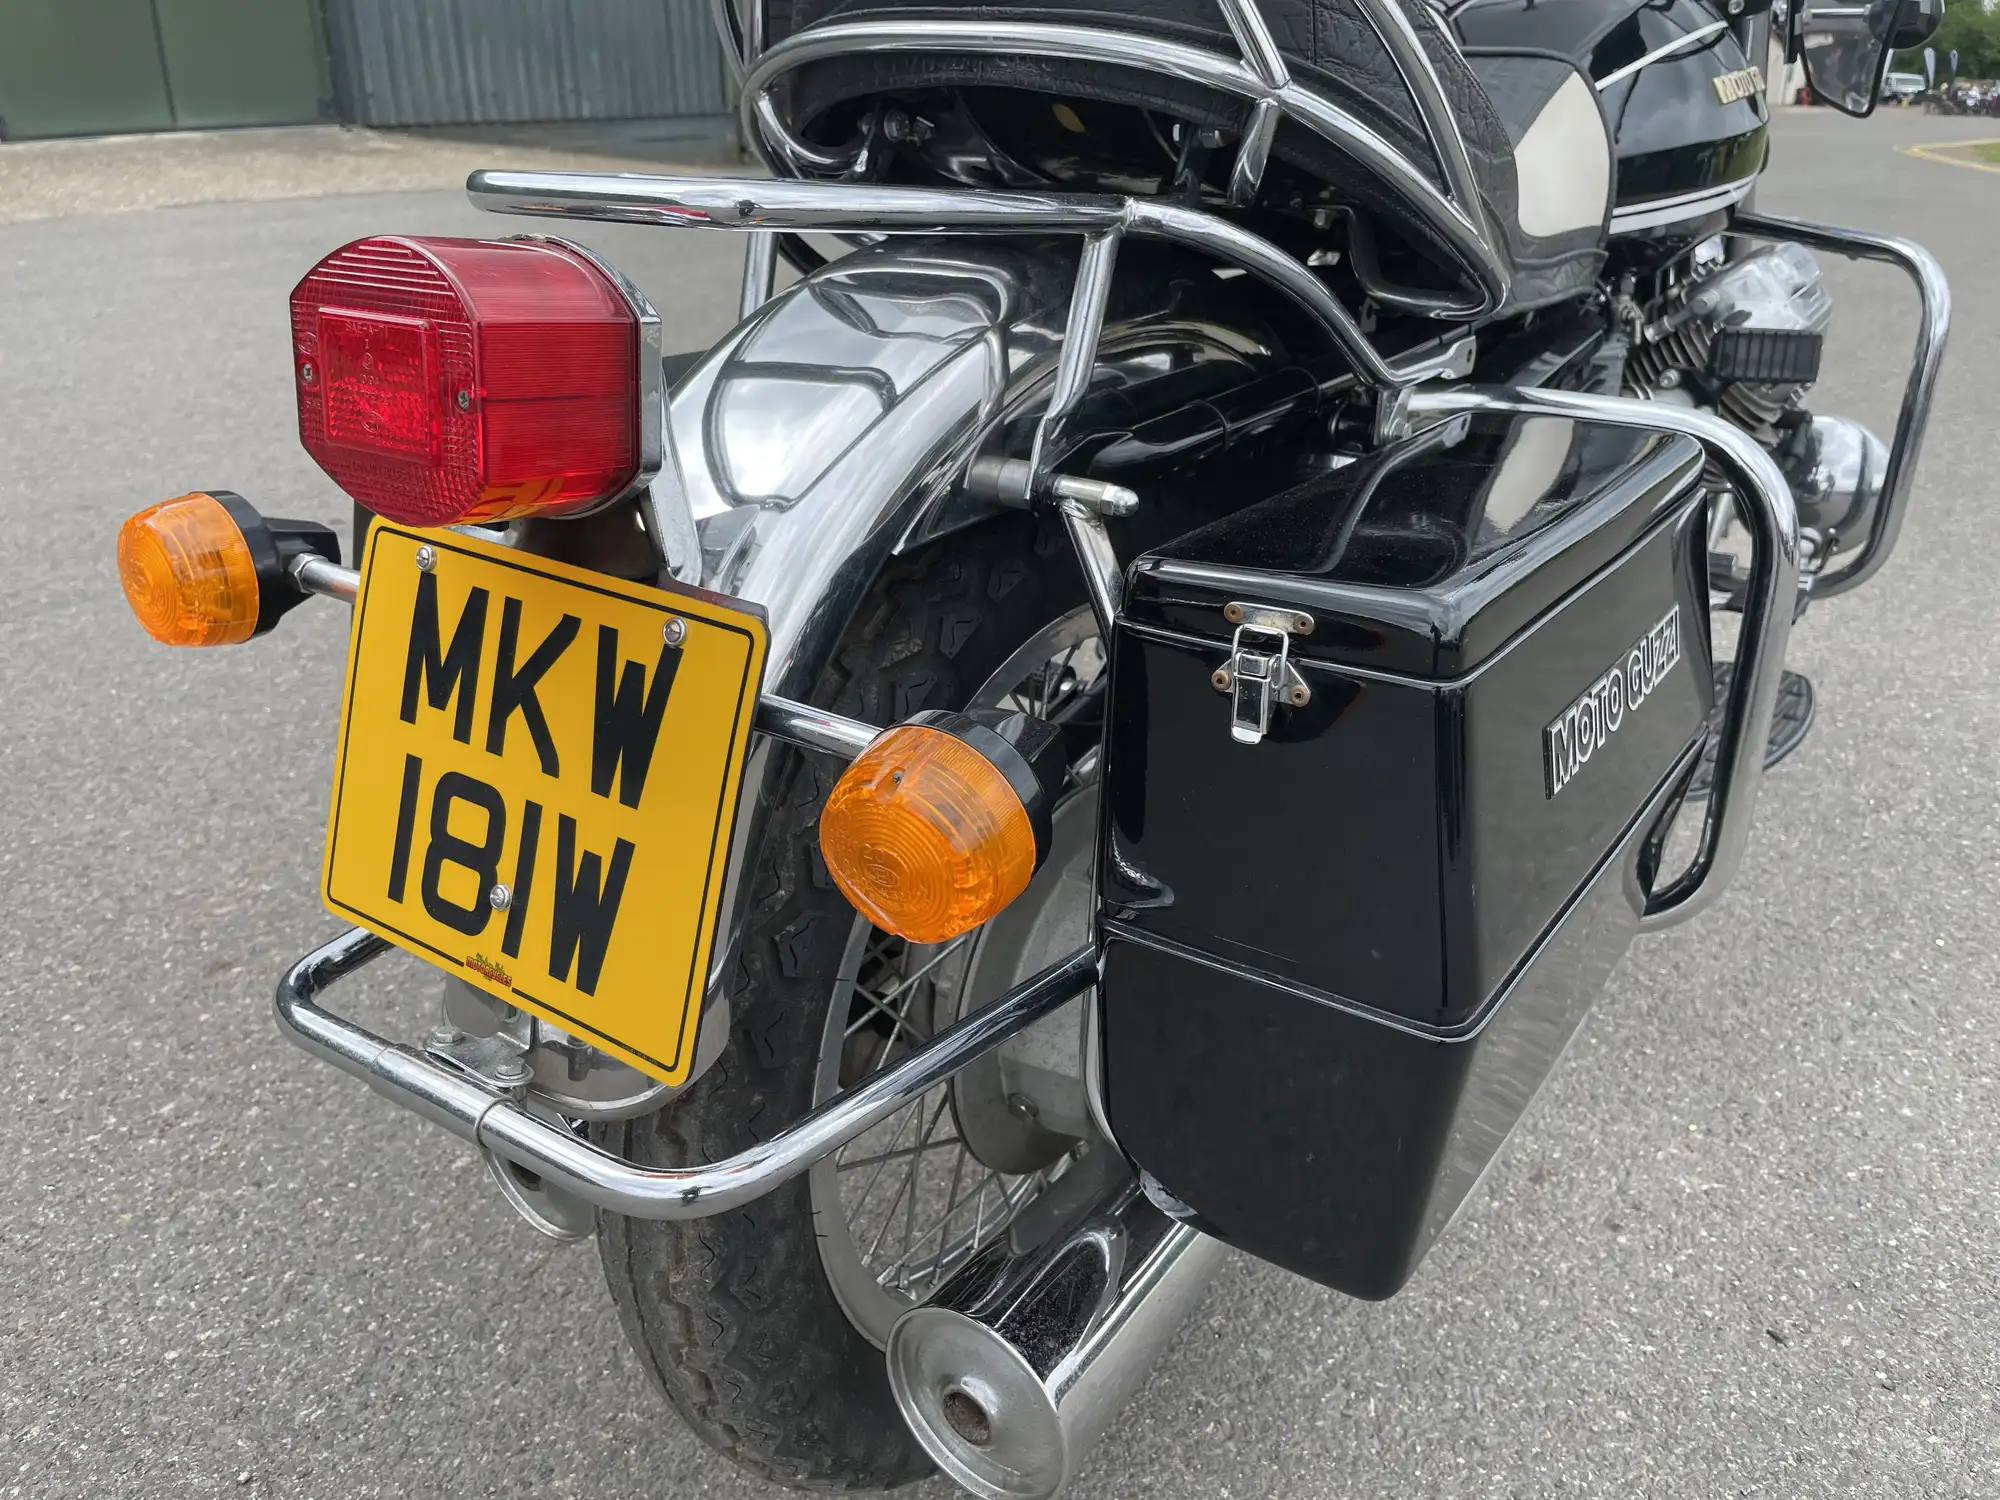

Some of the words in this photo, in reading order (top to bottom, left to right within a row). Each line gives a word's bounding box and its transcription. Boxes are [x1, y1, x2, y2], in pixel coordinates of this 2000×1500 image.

[400, 571, 683, 811] MKW
[1551, 667, 1624, 795] MOTO
[1627, 602, 1681, 711] GUZZI
[388, 752, 636, 997] 181W
[466, 956, 512, 987] MOTORCYCLES
